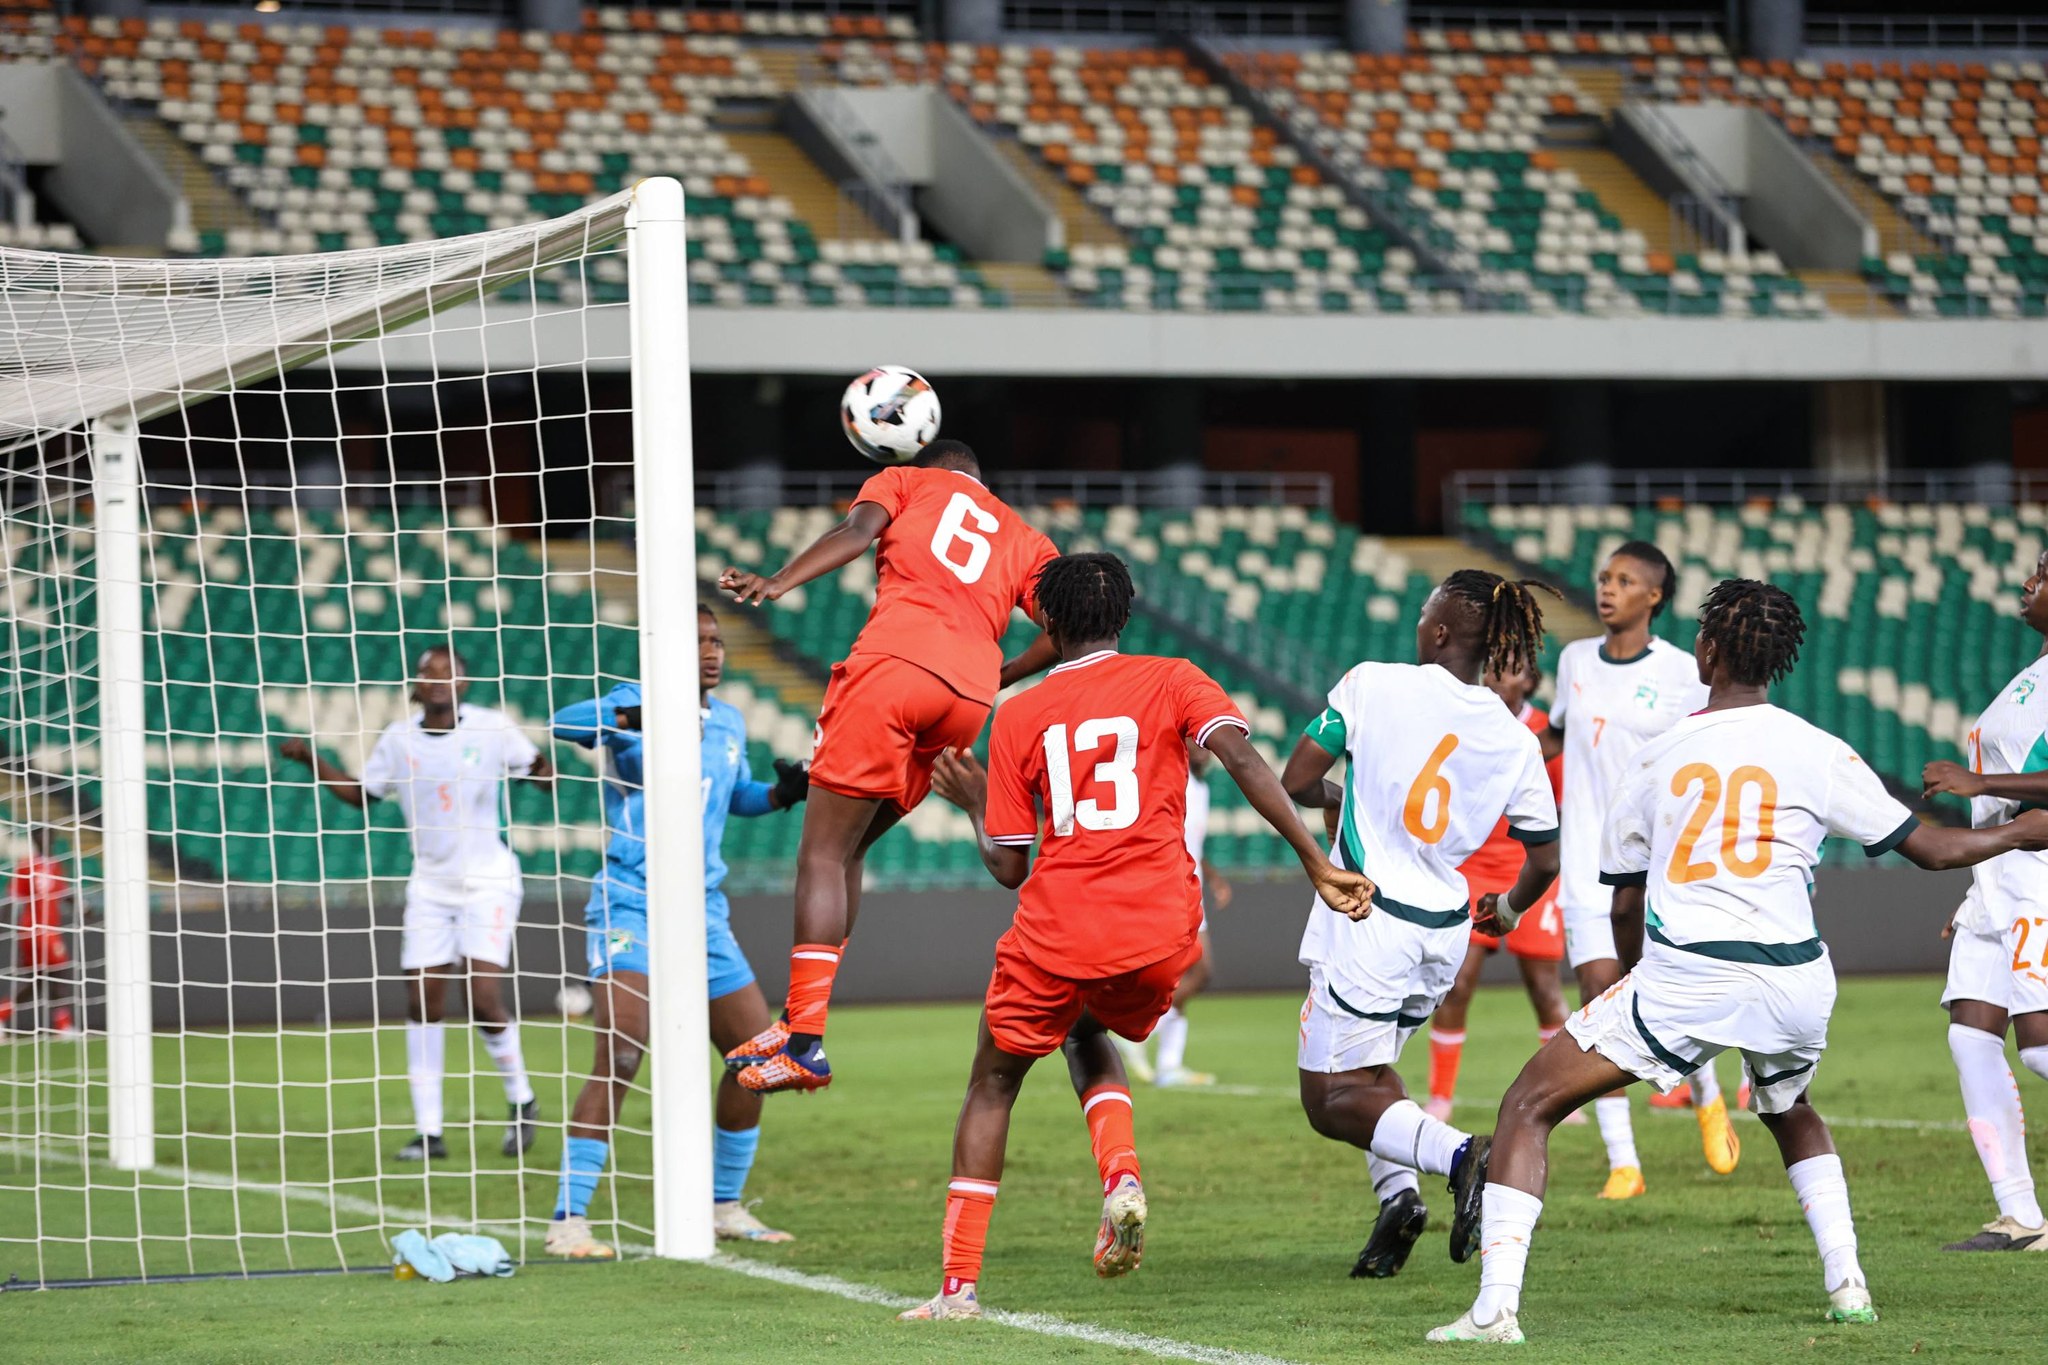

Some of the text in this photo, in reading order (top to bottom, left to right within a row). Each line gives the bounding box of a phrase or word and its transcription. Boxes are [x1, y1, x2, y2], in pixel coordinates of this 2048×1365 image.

[930, 492, 1000, 584] 6
[1042, 716, 1140, 837] 13
[1592, 716, 1606, 749] 7
[437, 784, 453, 812] 5
[1403, 733, 1459, 845] 6
[1667, 762, 1778, 884] 20
